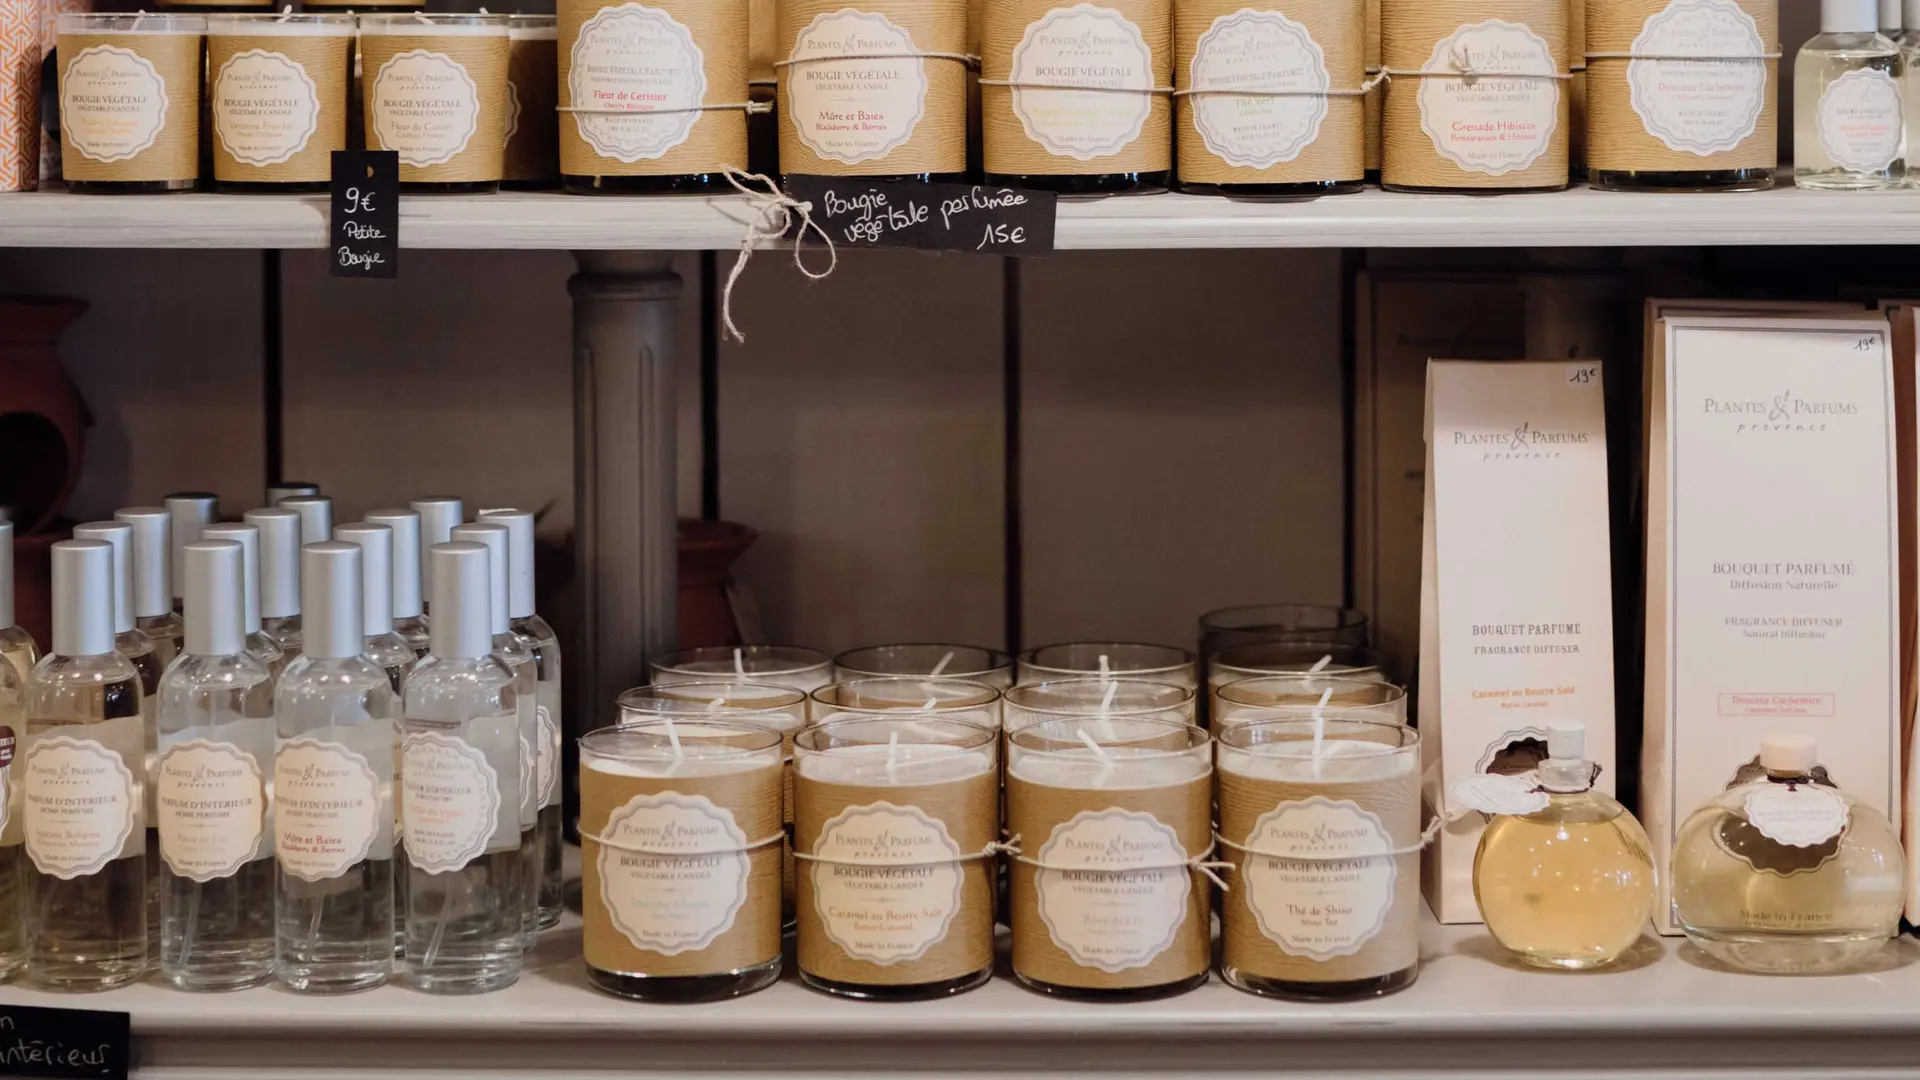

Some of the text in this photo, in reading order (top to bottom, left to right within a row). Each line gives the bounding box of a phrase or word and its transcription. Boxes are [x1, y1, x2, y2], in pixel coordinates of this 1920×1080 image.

[807, 40, 842, 49] PLANTES
[857, 40, 897, 49] PARFUMS
[1502, 51, 1538, 61] PARFUMS
[806, 69, 899, 81] BOUGIE VÉGÉTALE
[1036, 64, 1132, 77] BOUGIE VÉGÉTALE
[1445, 83, 1487, 92] BOUGIE
[594, 90, 668, 101] Fleur de Cerisier
[223, 99, 251, 107] BOUGIE
[383, 99, 413, 108] BOUGIE
[819, 110, 884, 121] Mûre et Baies
[1452, 121, 1536, 132] Grenade Hibiscus
[344, 187, 377, 214] 9€
[824, 188, 888, 220] Bougie
[343, 221, 387, 240] Petite
[976, 223, 1027, 250] 15€
[338, 246, 386, 271] Bougie
[1705, 388, 1858, 421] PLANTES & PARFUMS
[1736, 423, 1828, 434] provence
[1454, 421, 1589, 450] PLANTES & PARFUMS
[1483, 452, 1561, 464] provence
[1712, 560, 1855, 576] BOUQUET PARFUMÉ
[1730, 579, 1839, 591] Diffusion Naturelle
[1724, 616, 1843, 627] FRAGRANCE DIFFUSER
[1472, 622, 1581, 636] BOUQUET PARFUMÉ
[1743, 629, 1826, 639] Natural Diffusion
[1474, 644, 1580, 656] FRAGRANCE DIFFUSER
[1472, 685, 1575, 699] Caramel au Beurre Salé
[624, 824, 661, 835] PLANTES
[677, 826, 719, 836] PARFUMS
[1270, 827, 1310, 839] PLANTES
[1327, 828, 1368, 839] PARFUMS
[316, 835, 342, 845] Baies
[836, 832, 873, 846] PLANTES
[890, 836, 933, 847] PARFUMS
[1065, 837, 1105, 850] PLANTES
[1122, 839, 1163, 850] PARFUMS
[620, 856, 660, 868] BOUGIE
[1268, 859, 1310, 872] BOUGIE
[833, 866, 875, 878] BOUGIE
[1062, 870, 1107, 882] BOUGIE
[828, 906, 942, 921] Caramel au Beurre Salé
[1286, 903, 1307, 917] Thé
[1309, 907, 1321, 916] de
[1740, 909, 1834, 921] Made in France
